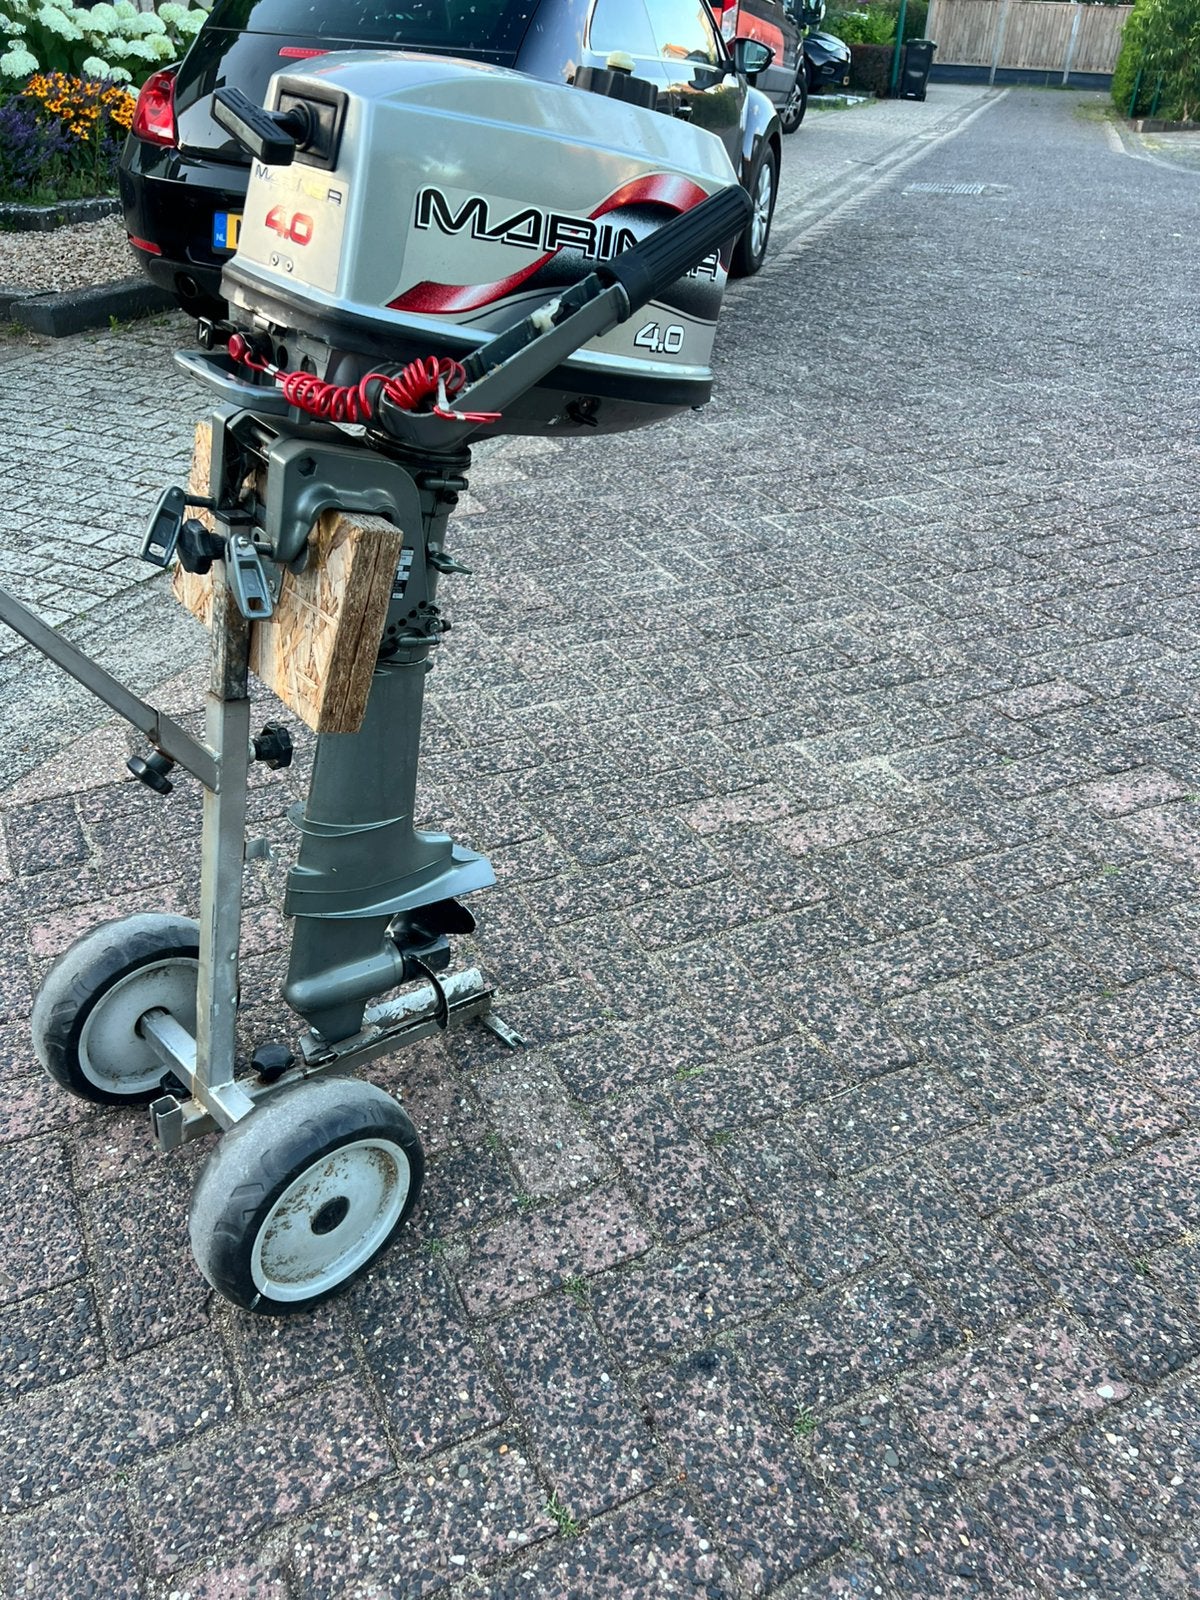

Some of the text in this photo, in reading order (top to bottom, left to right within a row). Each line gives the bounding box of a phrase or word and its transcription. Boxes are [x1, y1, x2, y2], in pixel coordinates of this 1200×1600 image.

[215, 233, 226, 242] NL
[265, 204, 314, 246] 4.0
[634, 321, 685, 354] 4.0
